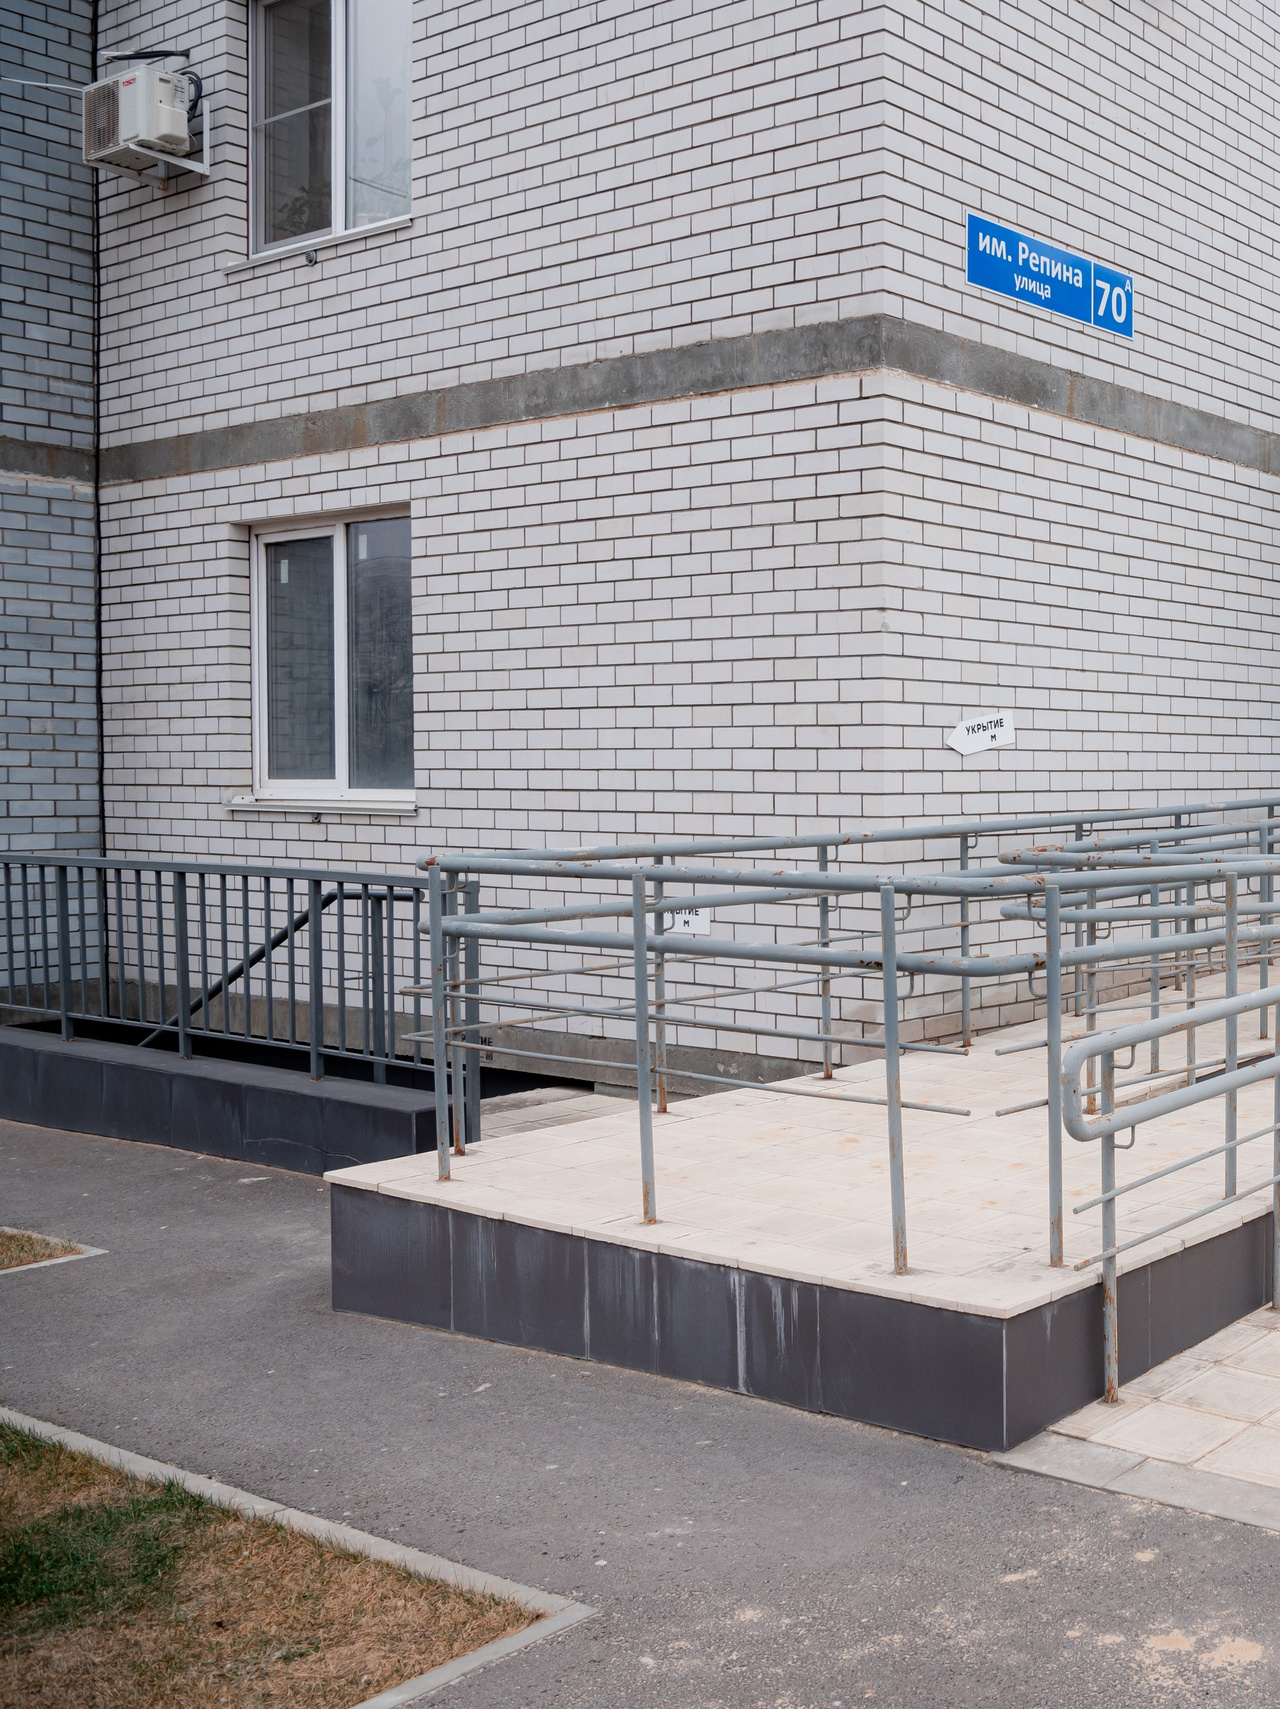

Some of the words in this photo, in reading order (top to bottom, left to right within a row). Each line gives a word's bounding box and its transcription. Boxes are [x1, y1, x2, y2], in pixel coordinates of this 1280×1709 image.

[978, 232, 1013, 262] им.
[1018, 241, 1083, 288] Репина
[1013, 273, 1052, 300] улица
[965, 718, 1004, 736] УКРЫТИЕ
[990, 733, 997, 742] М
[683, 919, 690, 928] М
